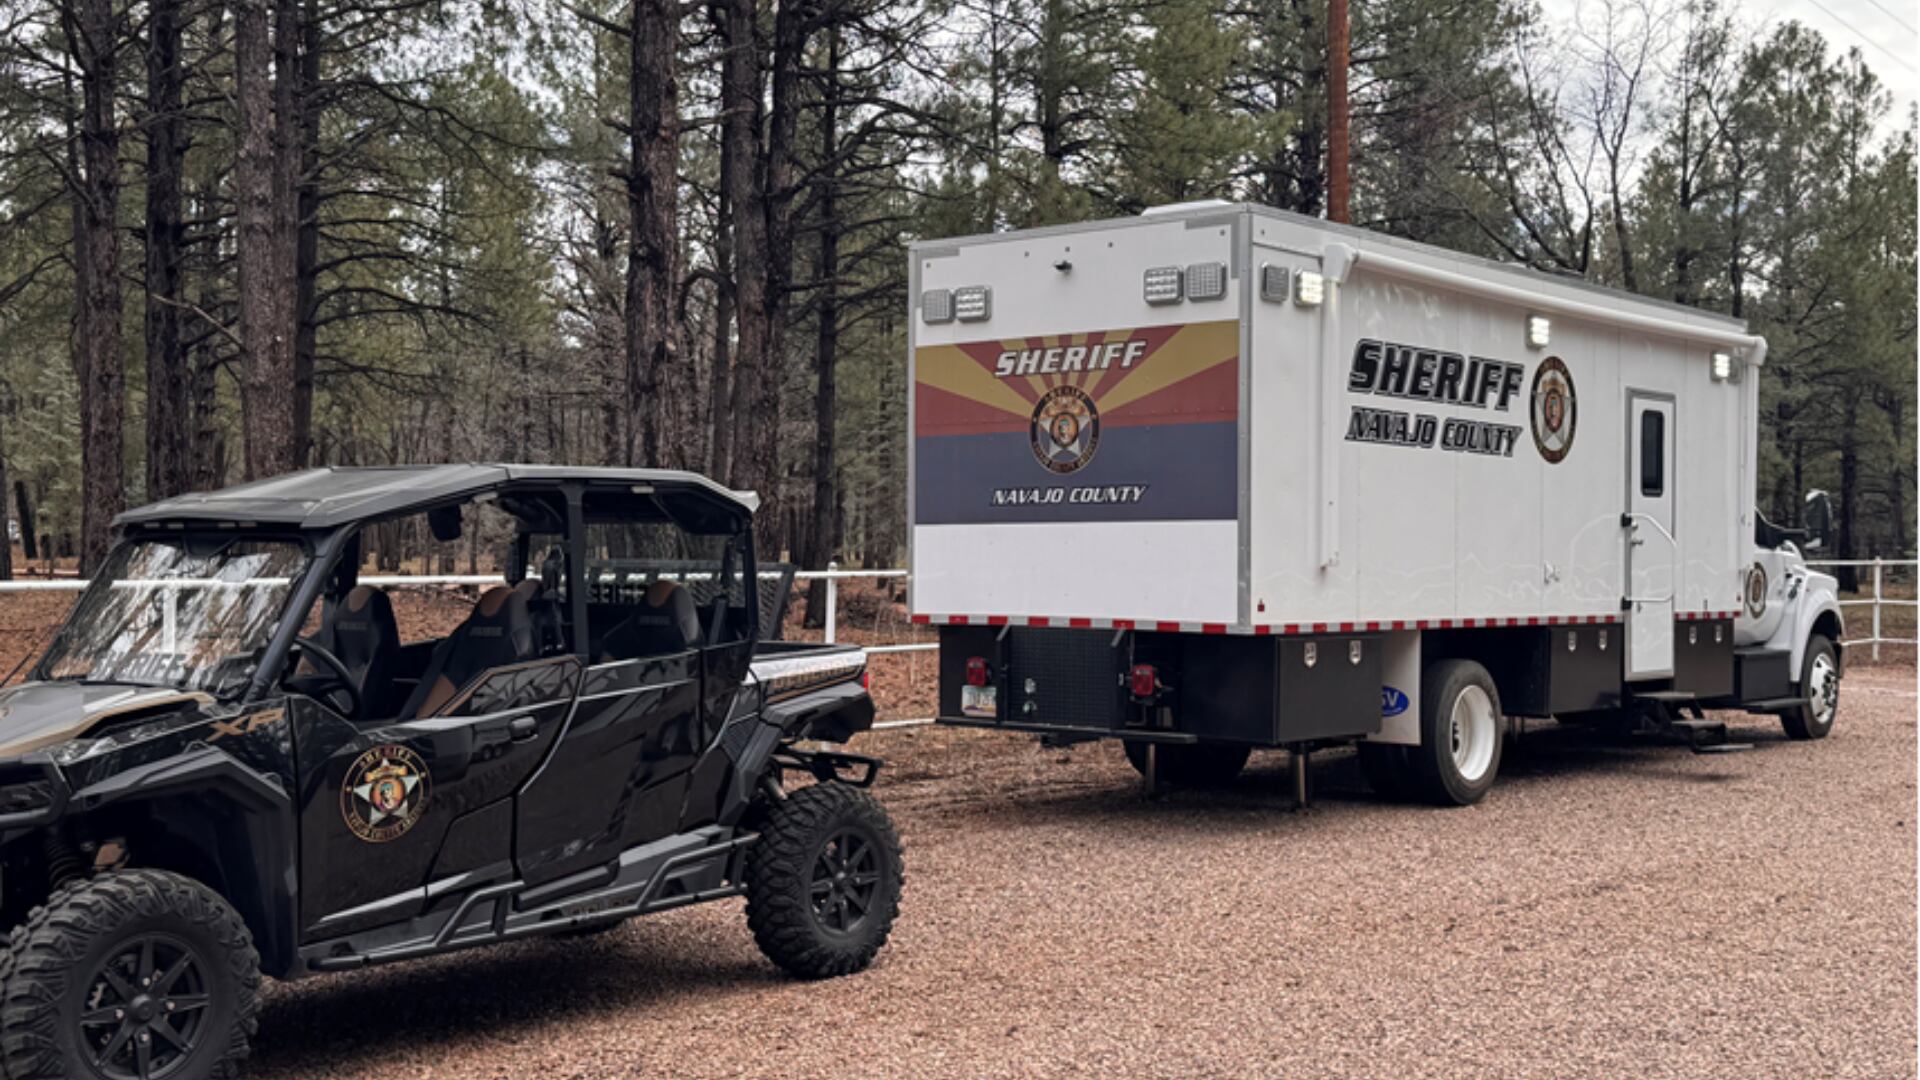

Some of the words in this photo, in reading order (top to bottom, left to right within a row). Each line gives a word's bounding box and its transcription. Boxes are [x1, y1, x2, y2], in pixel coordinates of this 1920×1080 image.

[994, 340, 1148, 377] SHERIFF
[1347, 338, 1525, 412] SHERIFF
[1344, 405, 1439, 449] NAVAJO
[1440, 416, 1524, 458] COUNTY
[992, 487, 1065, 505] NAVAJO
[1068, 485, 1147, 504] COUNTY
[206, 707, 285, 742] XP
